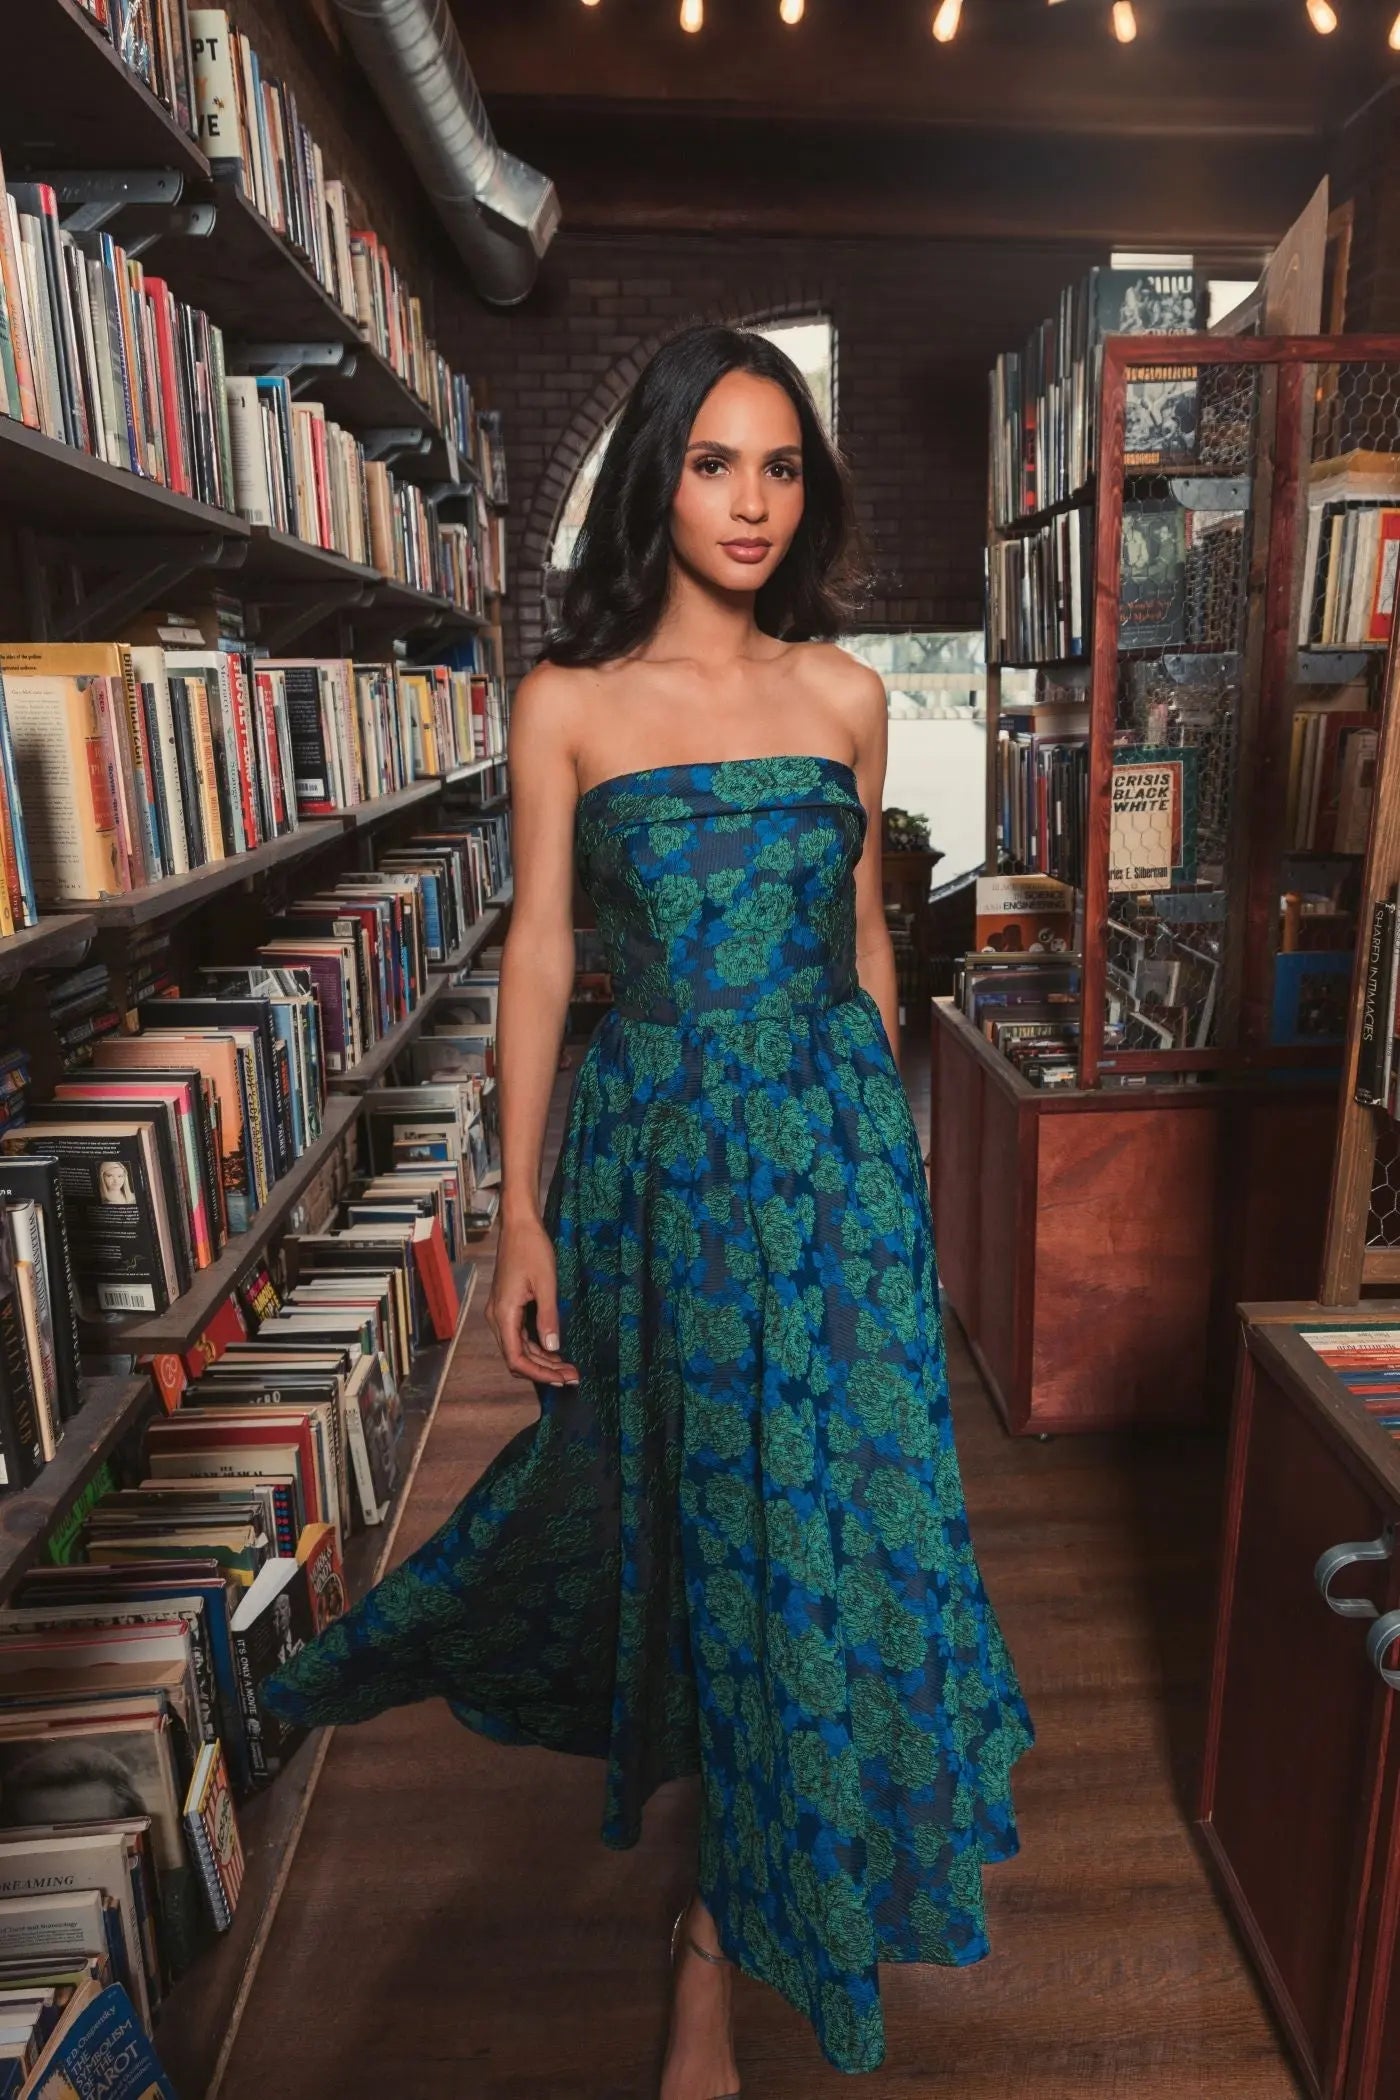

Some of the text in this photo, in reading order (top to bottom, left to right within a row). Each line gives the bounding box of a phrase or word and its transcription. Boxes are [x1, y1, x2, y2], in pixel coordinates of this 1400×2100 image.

[1112, 787, 1169, 800] BLACK
[1114, 774, 1171, 787] CRISIS
[1113, 800, 1169, 812] WHITE
[1126, 868, 1132, 880] E.
[1134, 866, 1168, 879] Silberman
[10, 882, 20, 918] Wings
[1003, 901, 1065, 910] ENGINEERING
[1362, 909, 1383, 1041] SHARED INTIMACIES
[276, 1123, 285, 1156] PALMER
[27, 1210, 41, 1267] WILLIAM
[0, 1300, 34, 1445] WALLY LAMB
[235, 1637, 247, 1655] IT'S
[239, 1655, 252, 1680] ONLY
[243, 1678, 253, 1687] A
[244, 1686, 258, 1715] MOVIE
[0, 1875, 74, 1892] REAMING
[78, 2004, 117, 2049] Ouspensky
[71, 2048, 91, 2076] THE
[76, 2019, 133, 2086] SYMBOLISM
[81, 2050, 115, 2097] OF THE
[86, 2039, 139, 2100] TAROT
